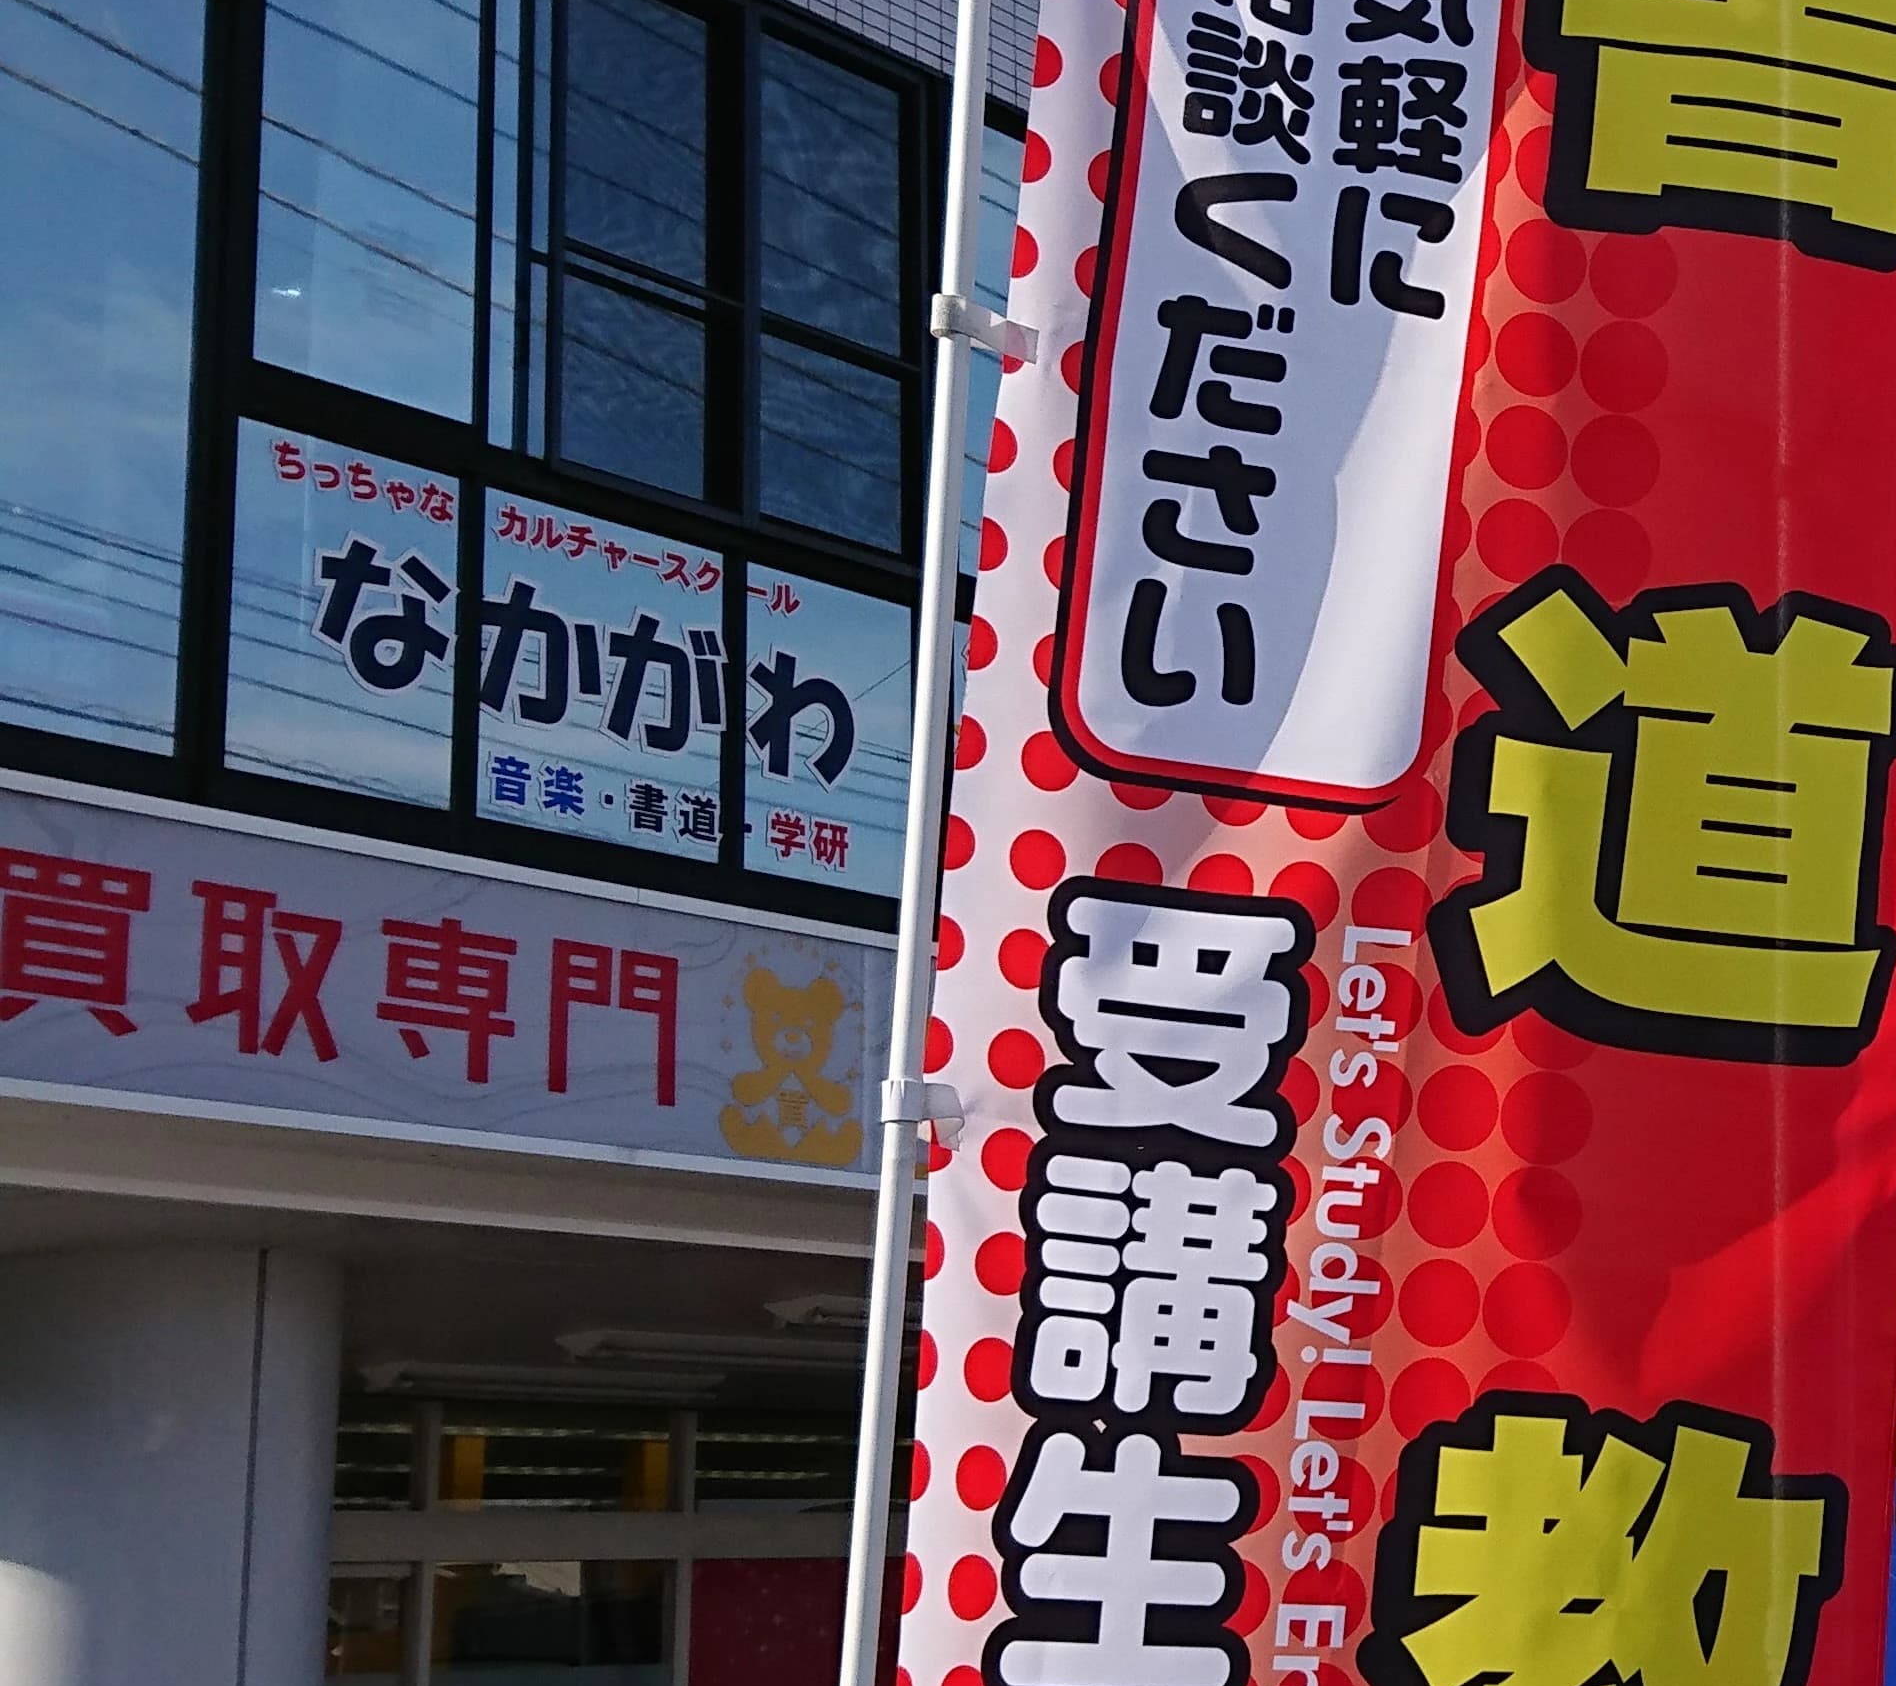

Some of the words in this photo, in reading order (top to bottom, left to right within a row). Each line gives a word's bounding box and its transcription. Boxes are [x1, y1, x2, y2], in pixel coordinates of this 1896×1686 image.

[272, 440, 456, 523] ちっちゃな
[499, 504, 801, 615] カルチャースクール
[317, 538, 857, 790] なかがわ
[490, 754, 850, 870] 音楽・書道・学研
[0, 847, 679, 1108] 買取専門
[1328, 924, 1412, 1089] Let's
[1287, 1118, 1393, 1364] Study!
[1279, 1401, 1368, 1572] Let's
